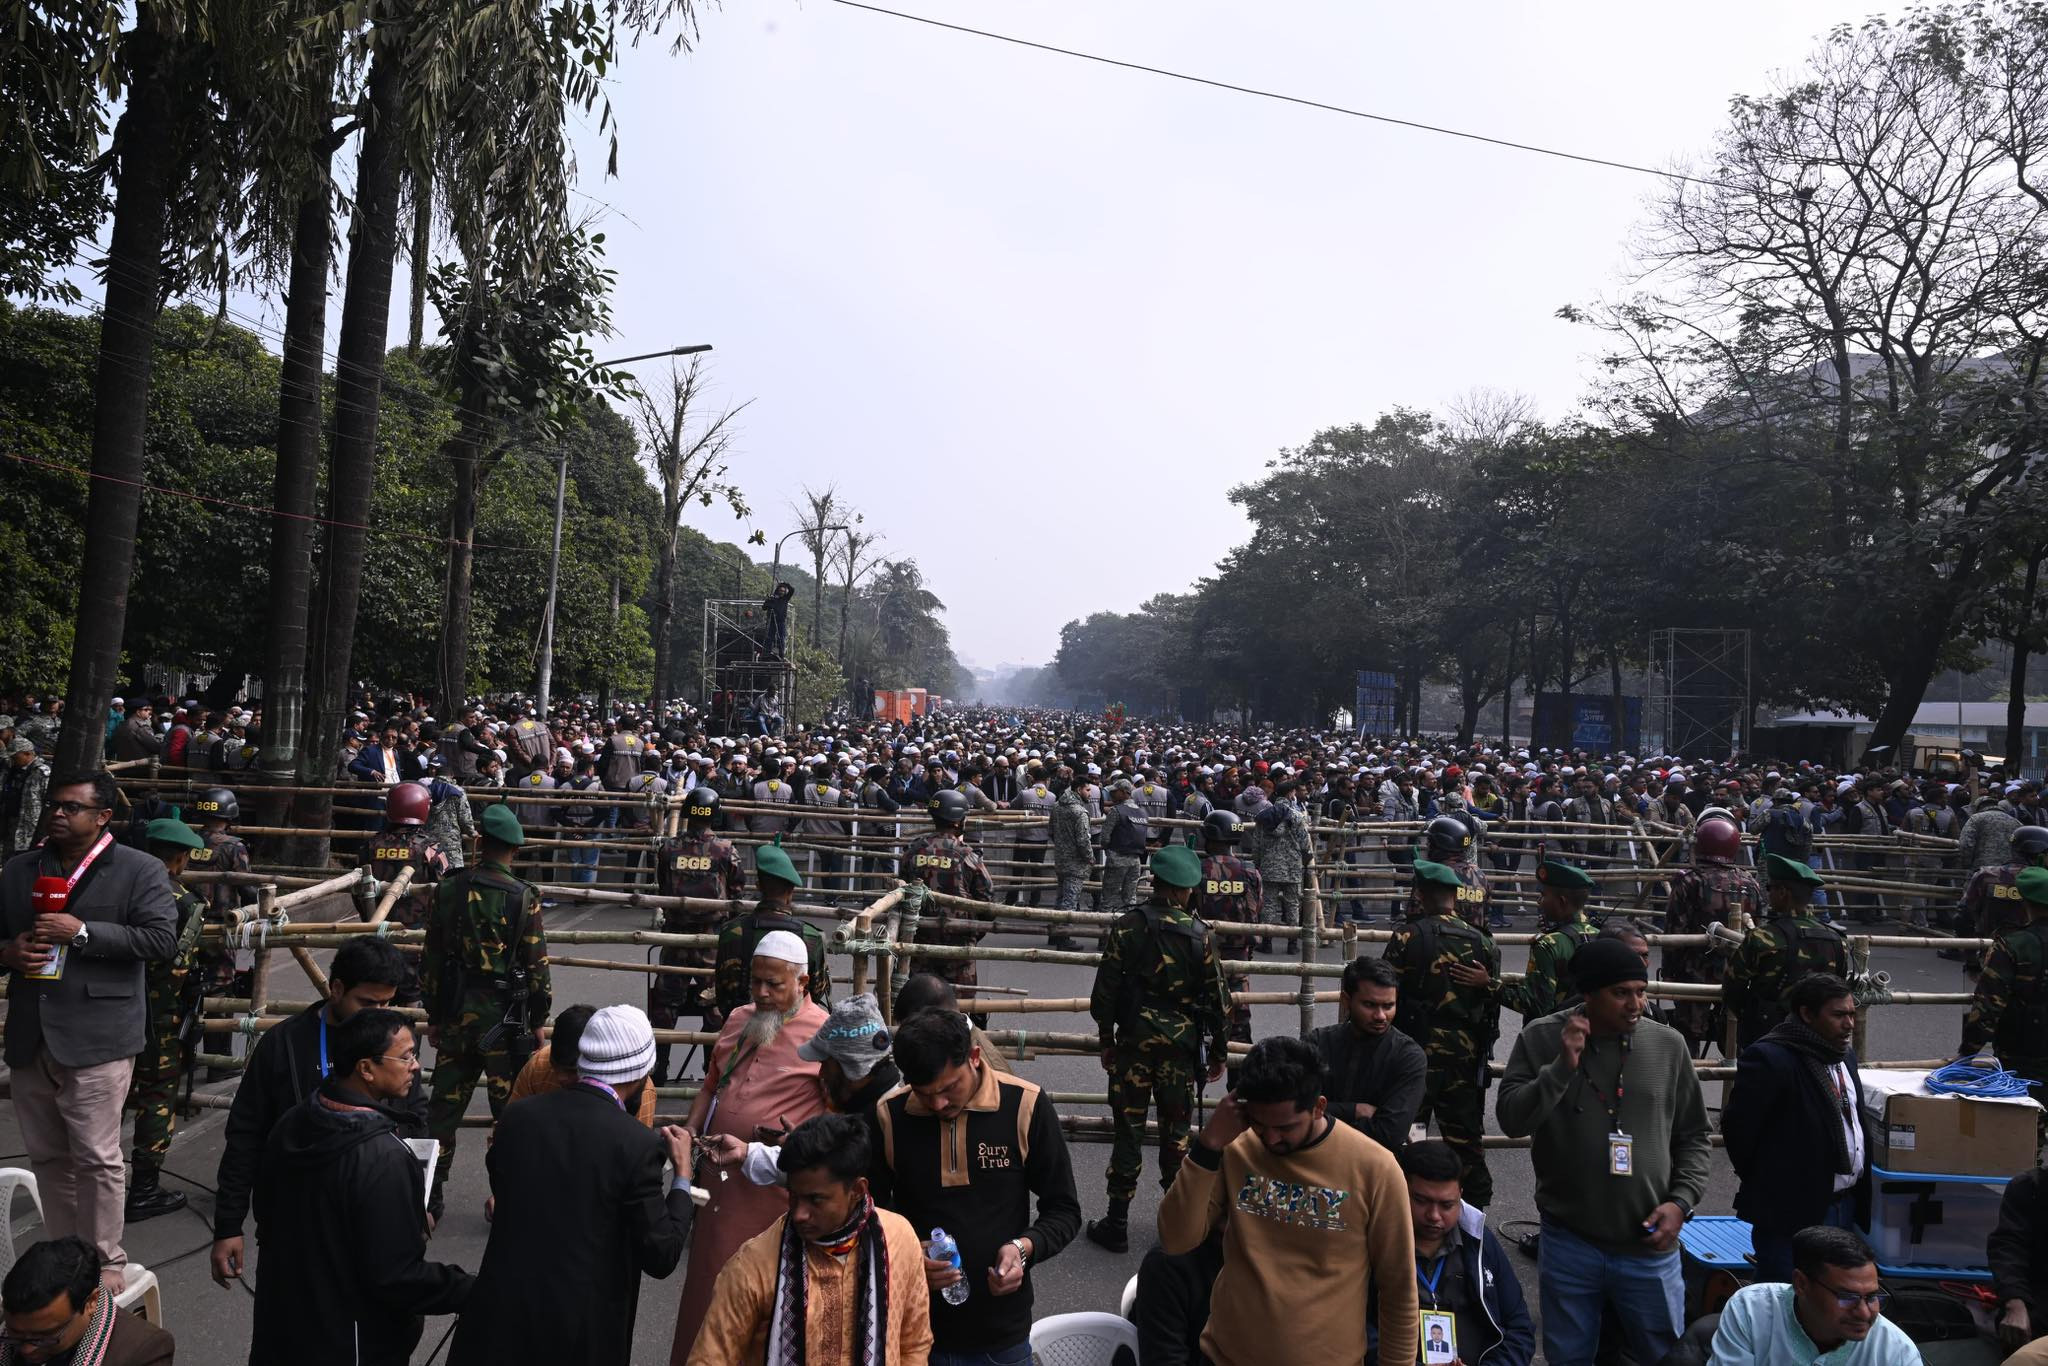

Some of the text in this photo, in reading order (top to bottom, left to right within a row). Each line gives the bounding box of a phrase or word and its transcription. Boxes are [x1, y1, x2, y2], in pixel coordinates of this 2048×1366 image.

[197, 802, 218, 811] BGB
[690, 806, 712, 816] BGB
[376, 848, 410, 860] BGB
[676, 856, 712, 870] BGB
[916, 855, 952, 869] BGB
[1206, 880, 1245, 894] BGB
[1456, 886, 1485, 902] BGB
[829, 1020, 880, 1039] phenix
[977, 1156, 1010, 1169] True
[1237, 1173, 1350, 1219] ARMY
